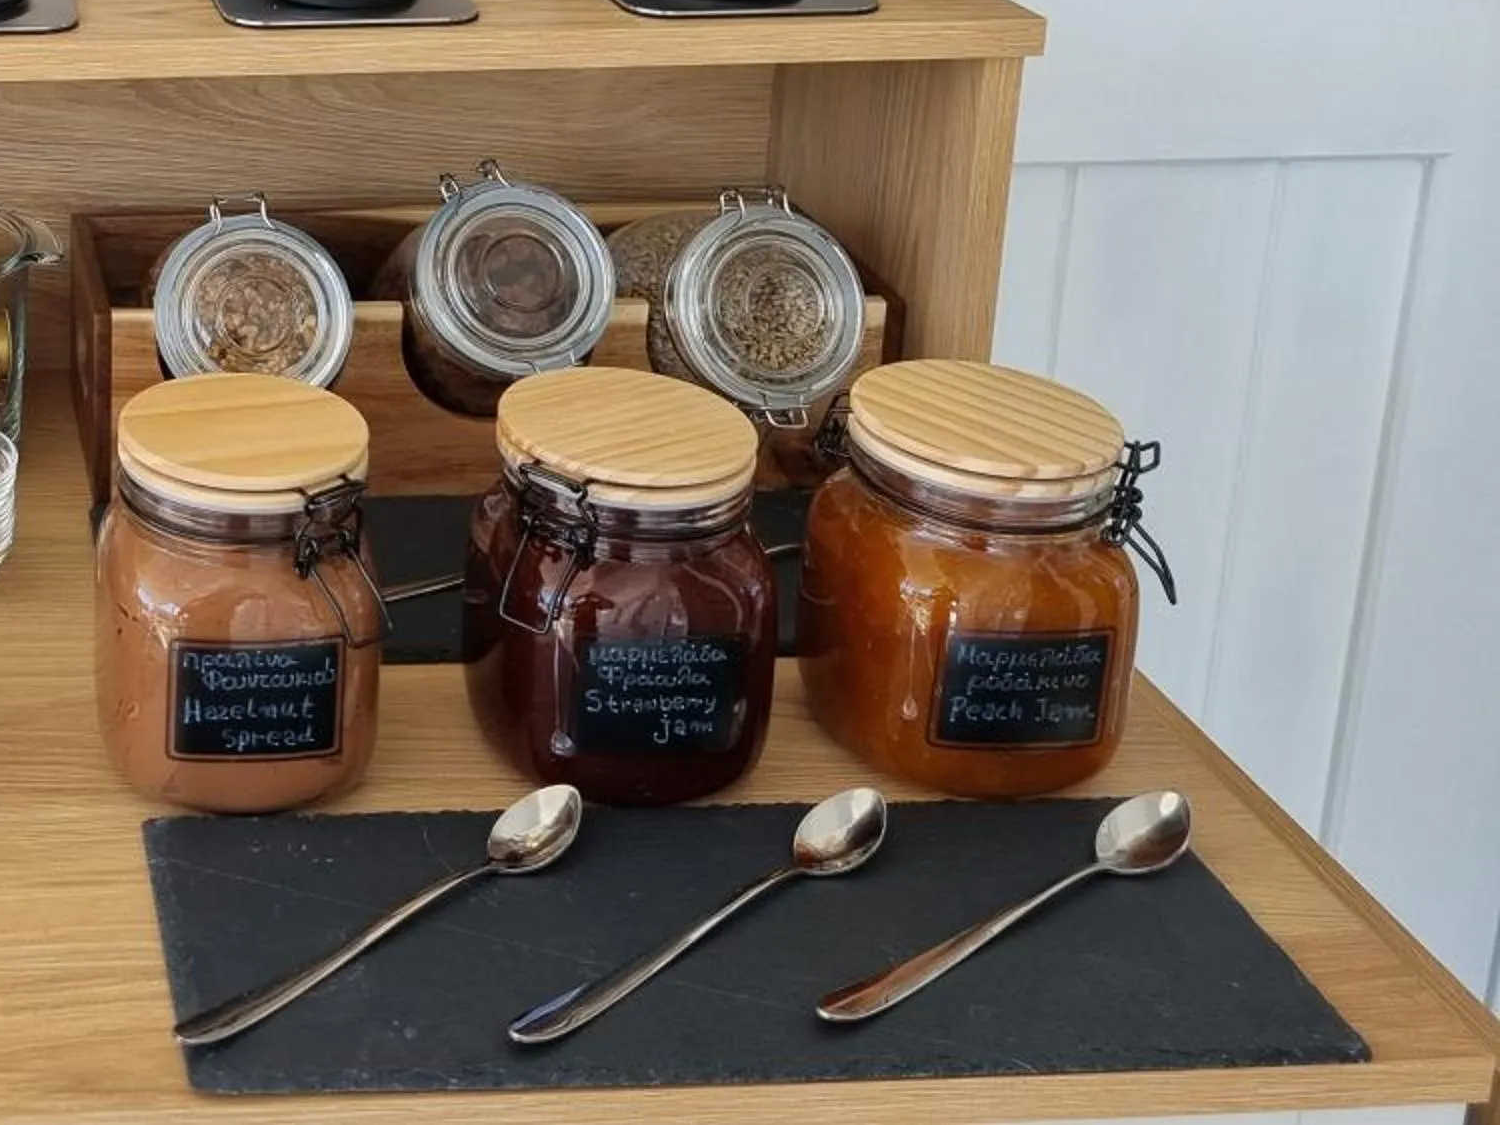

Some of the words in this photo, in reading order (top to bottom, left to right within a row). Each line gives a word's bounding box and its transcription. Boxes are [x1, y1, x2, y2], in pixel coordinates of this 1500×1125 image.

[184, 695, 316, 725] Hazelnut
[584, 689, 717, 714] Strawberry
[949, 696, 1023, 723] Peach
